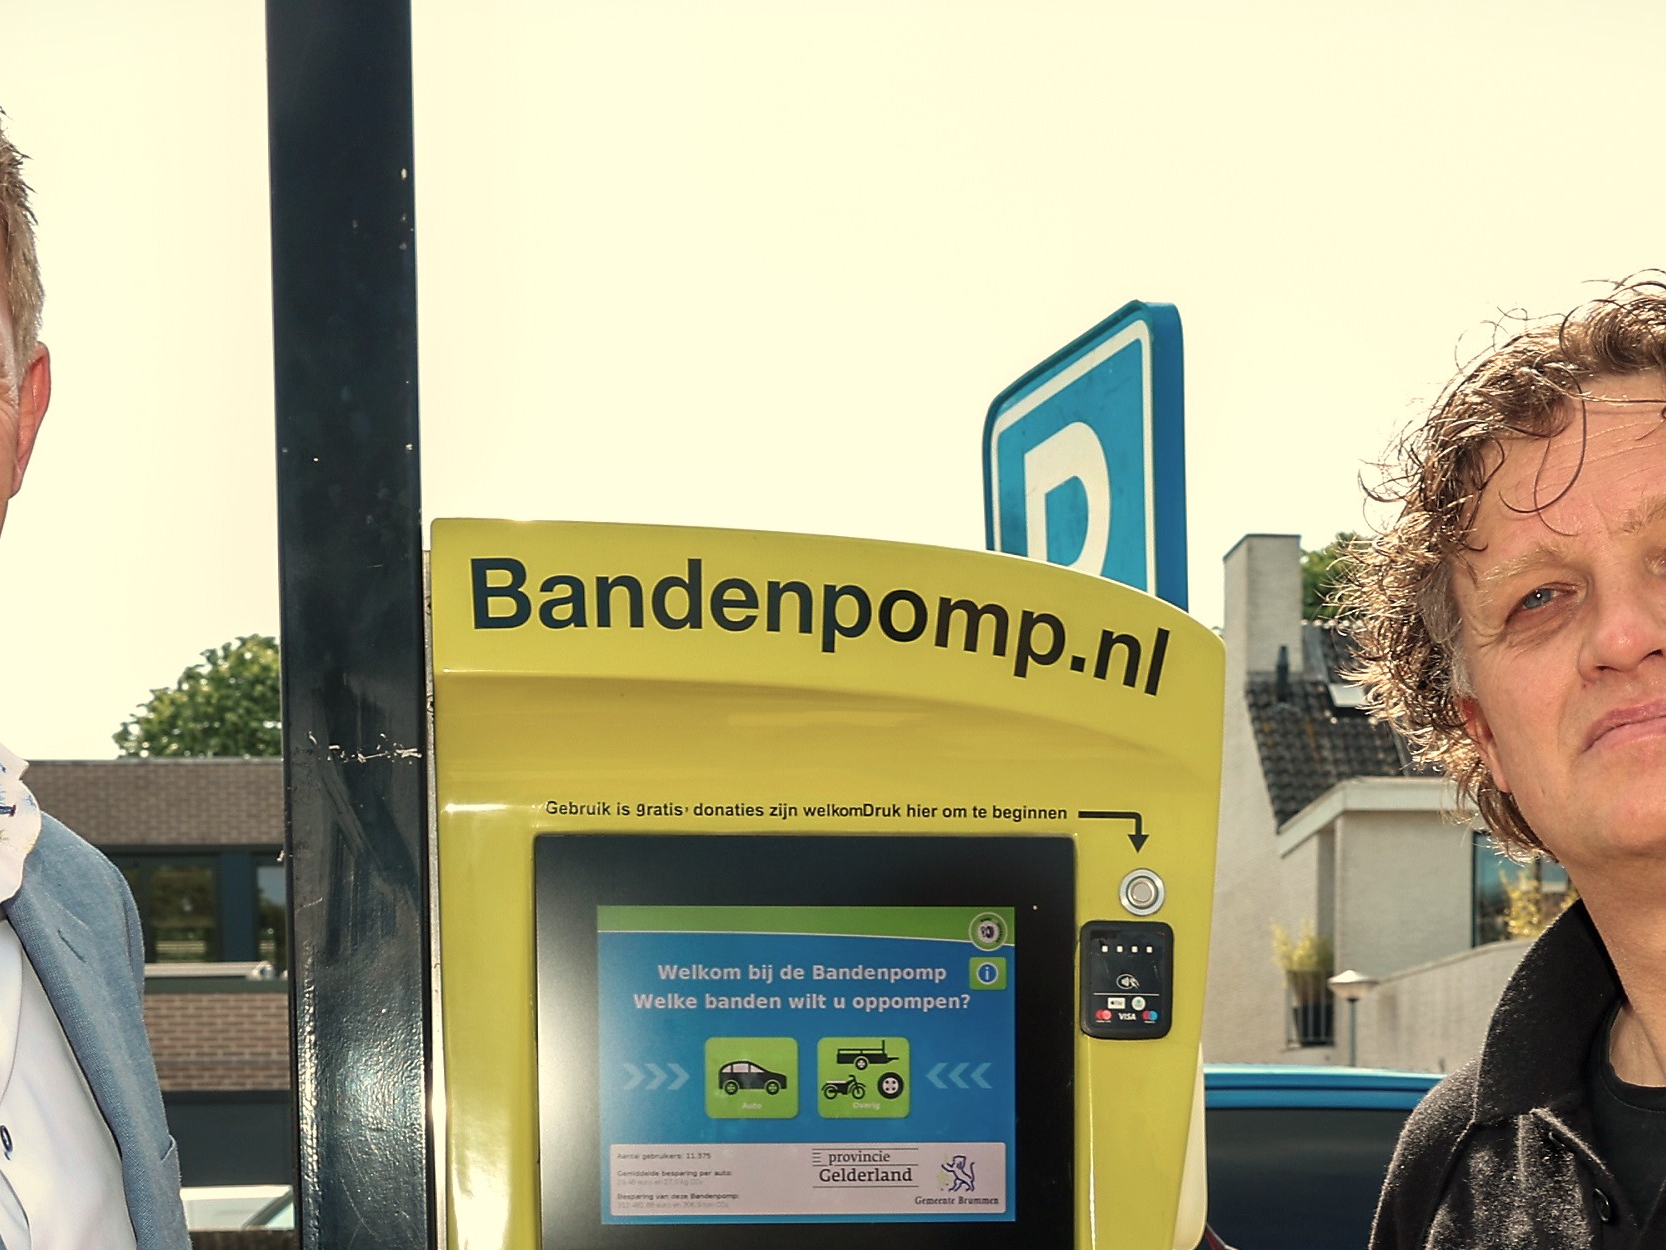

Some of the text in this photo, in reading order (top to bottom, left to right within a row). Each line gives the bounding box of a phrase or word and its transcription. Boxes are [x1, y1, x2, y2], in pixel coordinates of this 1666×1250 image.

[470, 557, 1170, 696] Bandenpomp.nl
[546, 801, 611, 815] Gebruik
[617, 802, 630, 815] is
[693, 803, 764, 816] donaties
[769, 803, 797, 820] zijn
[907, 804, 938, 817] hier
[942, 808, 967, 818] om
[972, 806, 987, 818] te
[993, 805, 1067, 822] beginnen
[658, 965, 946, 983] Welkom bij de Bandenpomp
[634, 993, 970, 1012] Welke banden wilt u oppompen?
[1118, 1012, 1137, 1021] VISA
[742, 1102, 763, 1111] Auto
[829, 1150, 891, 1166] provincie
[819, 1167, 914, 1183] Gelderland
[915, 1196, 999, 1205] Gemeente Brummen
